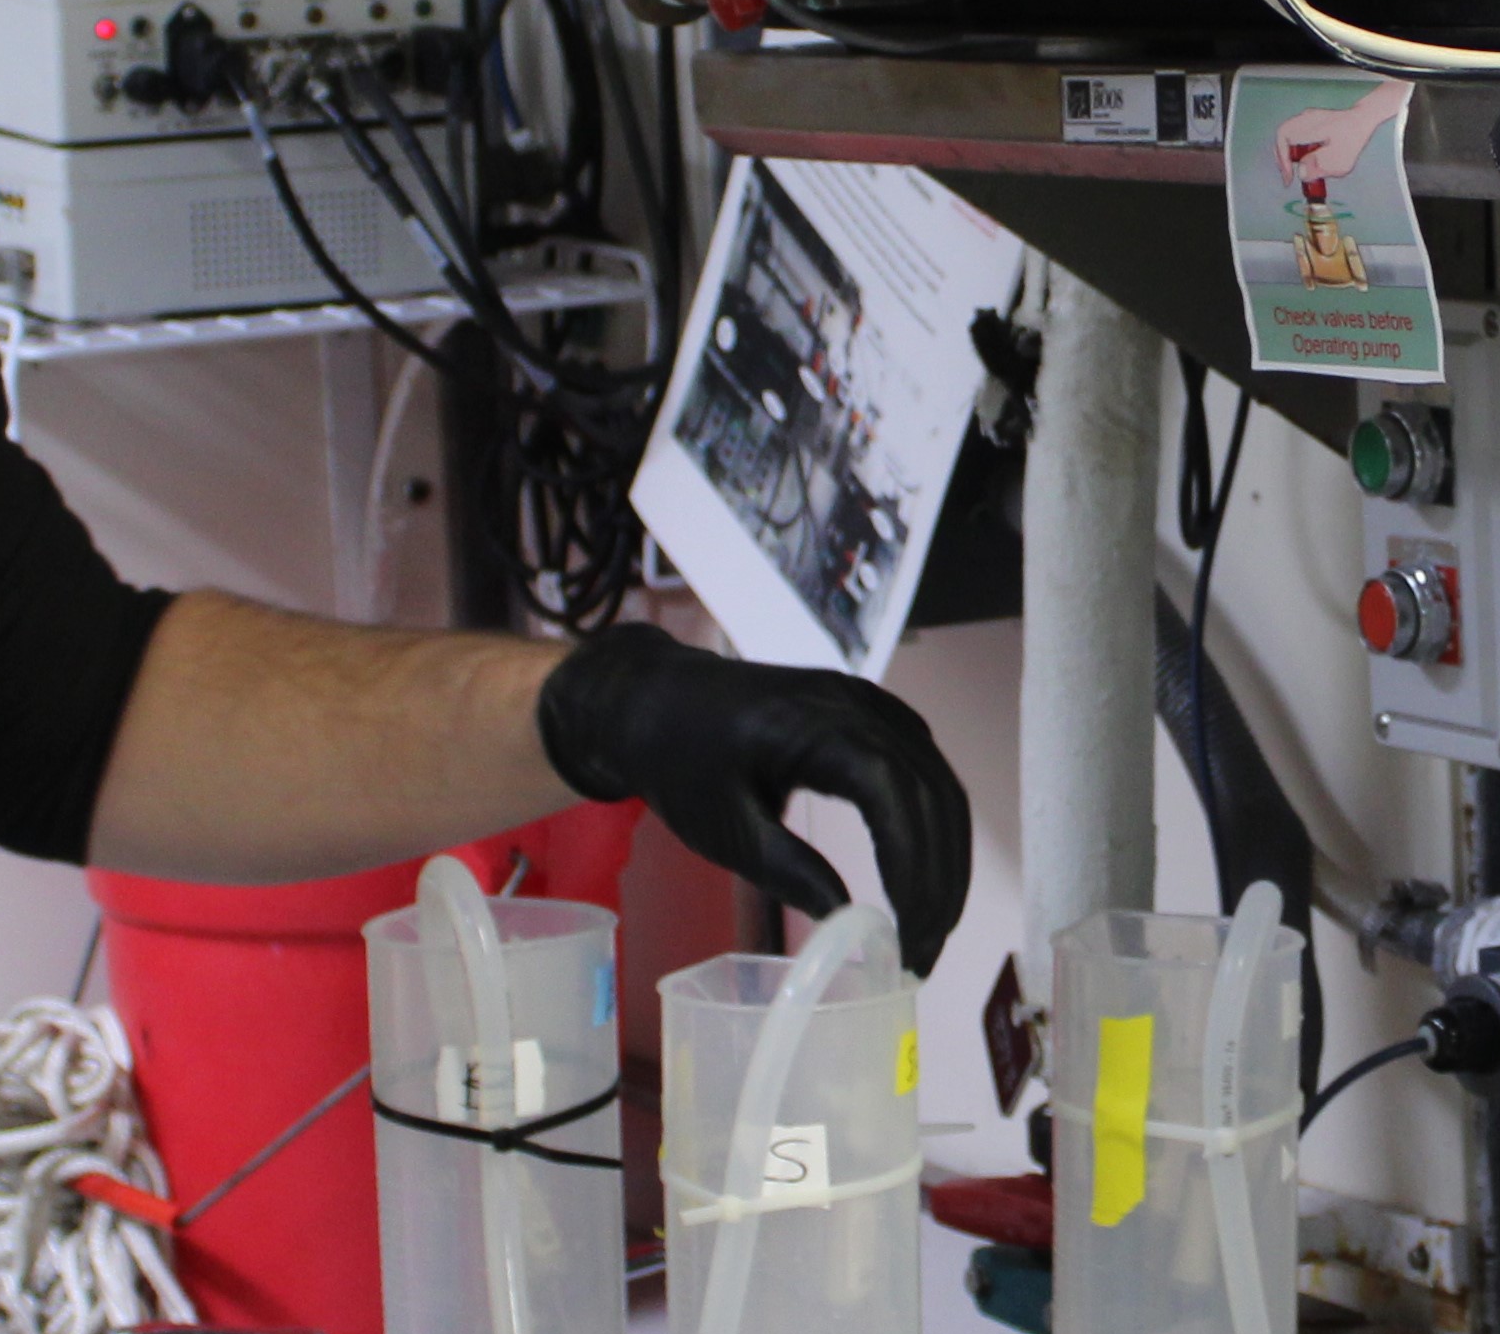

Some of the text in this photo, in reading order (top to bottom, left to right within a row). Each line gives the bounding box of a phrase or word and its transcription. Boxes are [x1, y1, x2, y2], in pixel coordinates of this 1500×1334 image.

[1273, 306, 1414, 331] Check valves before
[1292, 333, 1402, 364] Operating pump
[763, 1138, 810, 1184] S
